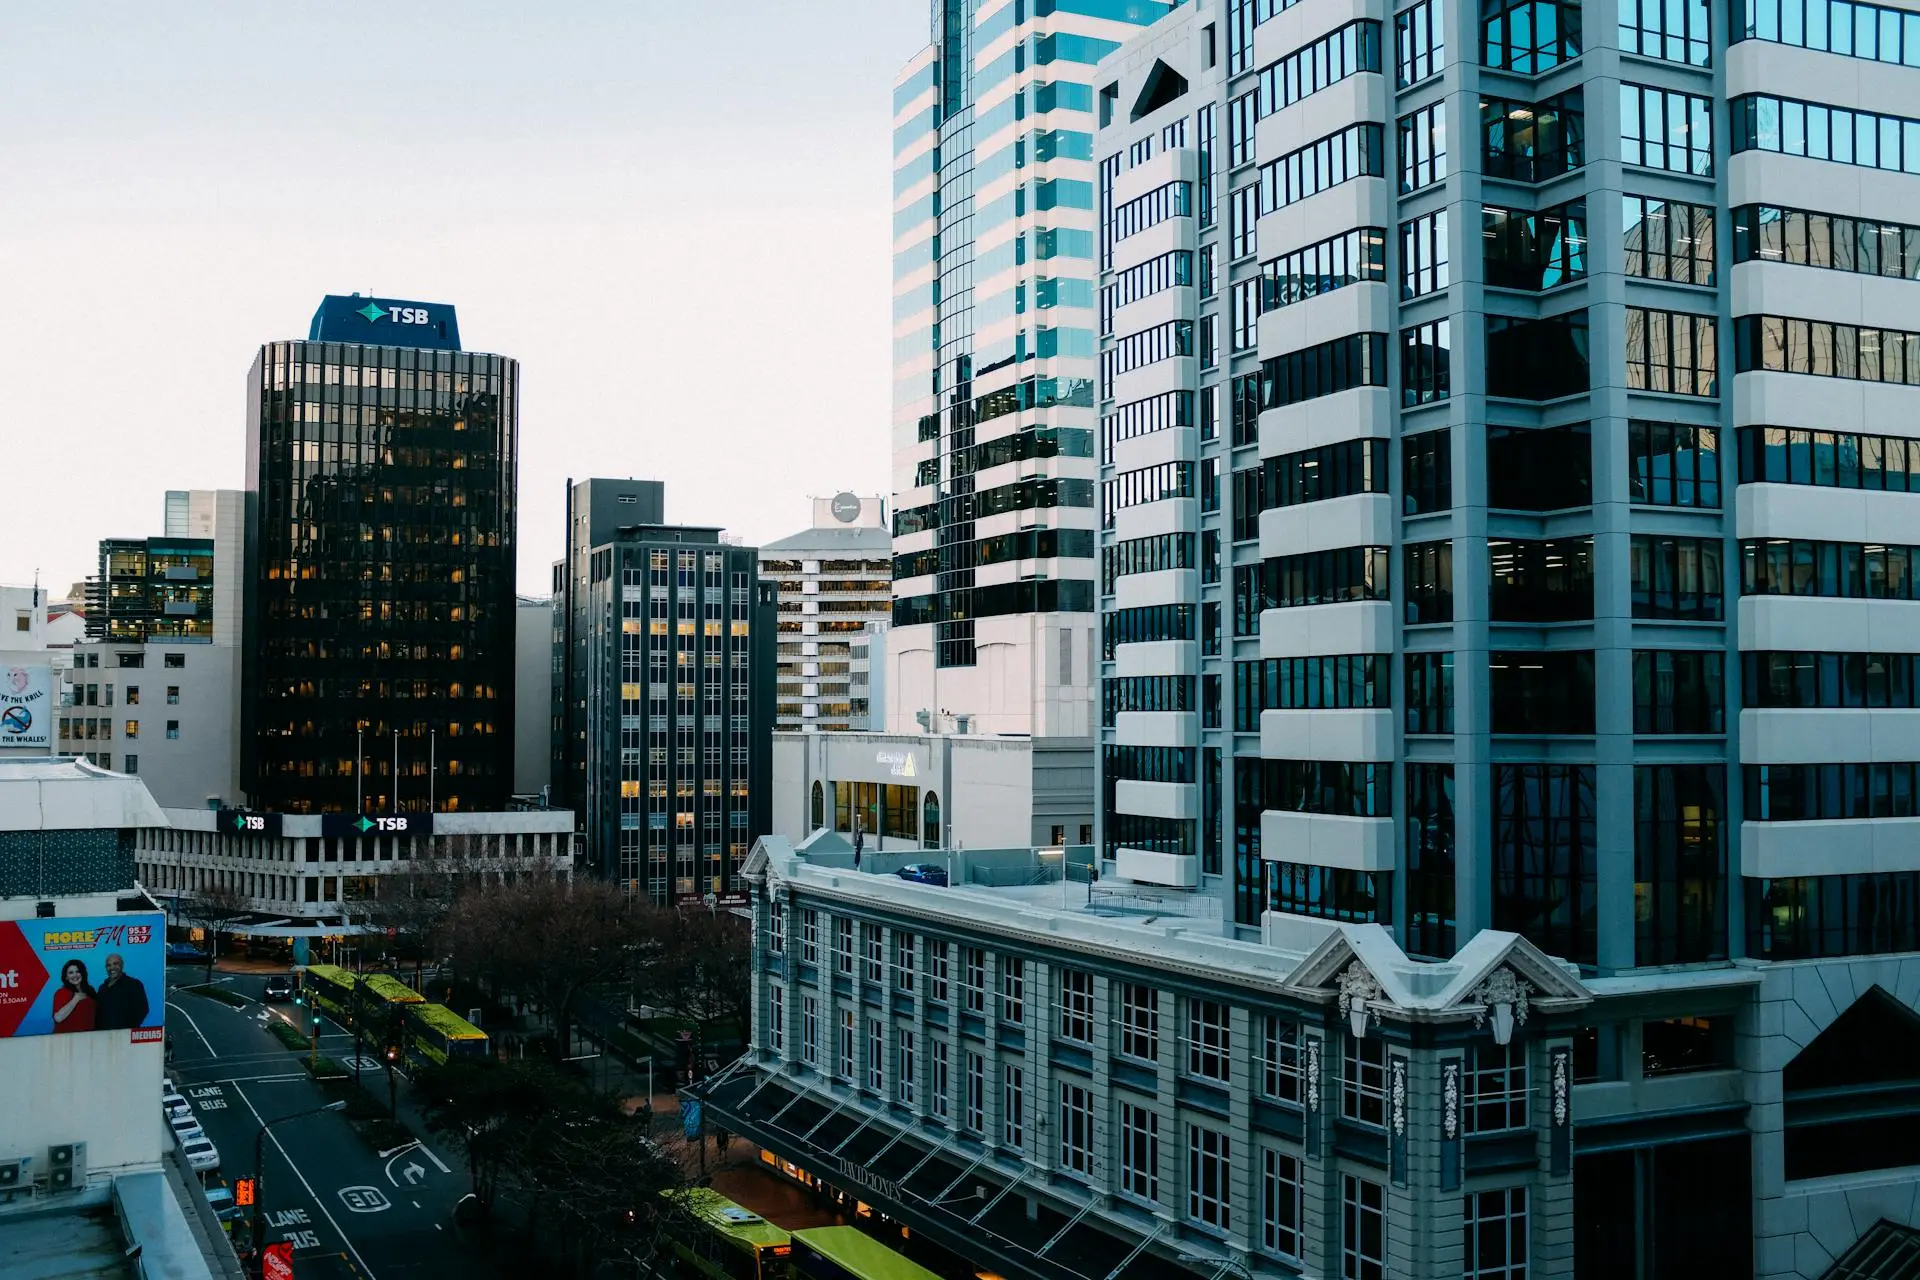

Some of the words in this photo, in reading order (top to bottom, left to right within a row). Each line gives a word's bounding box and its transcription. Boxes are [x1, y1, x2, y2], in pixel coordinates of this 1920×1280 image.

[389, 306, 429, 325] TSB
[0, 693, 9, 702] VE
[11, 696, 23, 704] THE
[24, 690, 44, 703] KRILL
[246, 816, 265, 830] TSB
[377, 818, 408, 831] TSB
[44, 930, 95, 945] MORE
[128, 926, 147, 935] 95.3
[128, 935, 147, 944] 99.7
[189, 1086, 223, 1098] LANE
[199, 1099, 228, 1110] BUS
[840, 1156, 868, 1186] DAVID
[867, 1171, 901, 1200] JONES
[348, 1191, 380, 1207] 30
[264, 1208, 311, 1228] LANE
